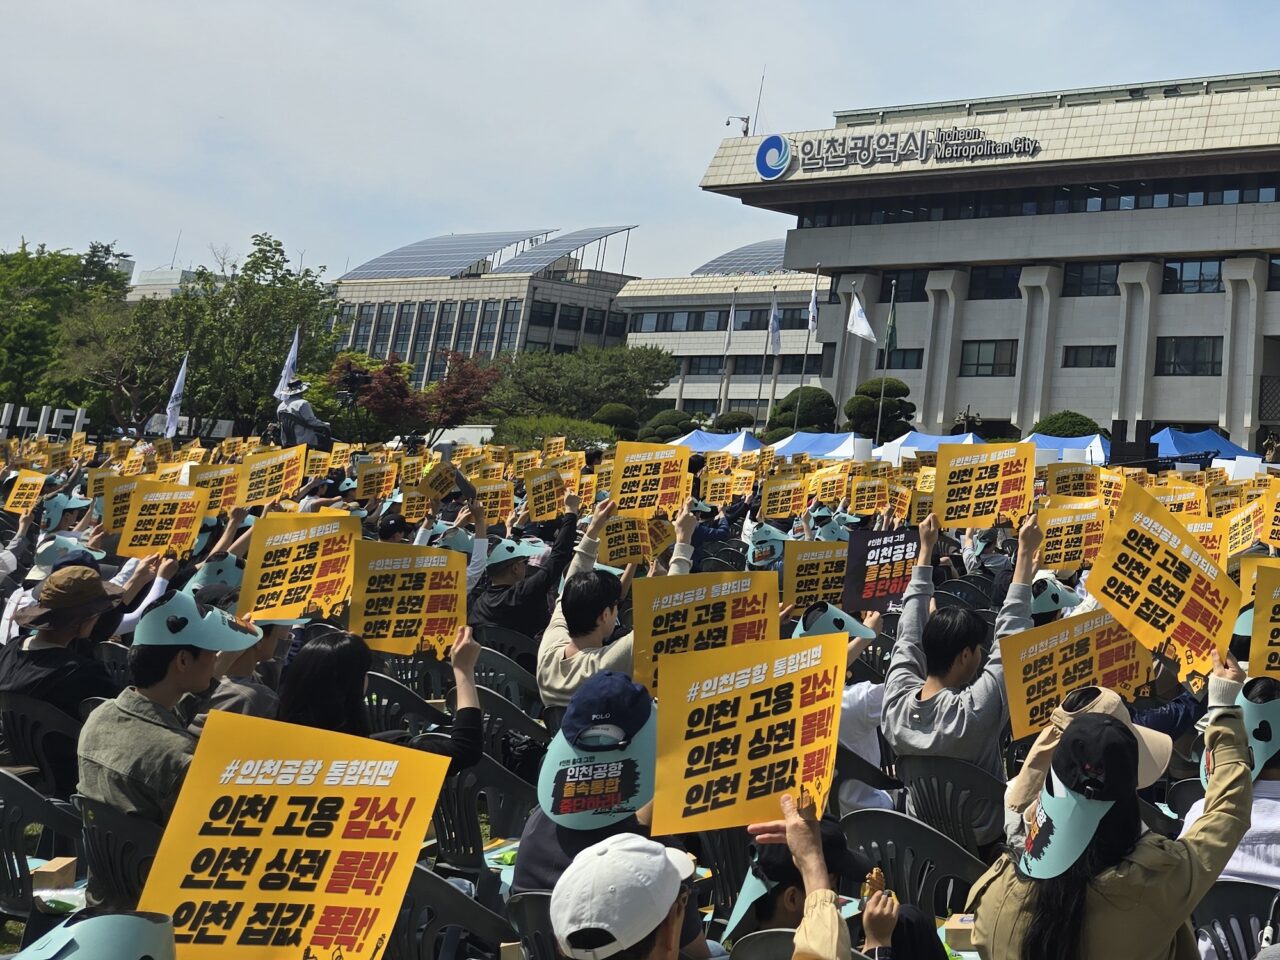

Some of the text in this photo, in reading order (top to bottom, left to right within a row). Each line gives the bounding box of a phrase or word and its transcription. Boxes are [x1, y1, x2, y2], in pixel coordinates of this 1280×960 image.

[800, 129, 927, 169] 인천광역시
[934, 128, 982, 142] Incheon
[934, 136, 1038, 159] Metropolitan City
[620, 475, 682, 495] 인천 상권 몰락!
[622, 460, 683, 479] 인천 고용 감소!
[618, 492, 681, 511] 인천 집값 폭락!
[262, 534, 353, 569] 인천 고용 감소!
[866, 542, 918, 566] 인천공항
[1133, 512, 1220, 581] #인천공항 통합되면
[258, 555, 351, 590] 인천 상권 몰락!
[366, 571, 460, 594] 인천 고용 감소!
[1122, 529, 1229, 614] 인천 고용 감소!
[252, 577, 346, 613] 인천 집값 폭락!
[364, 594, 459, 617] 인천 상권 몰락!
[653, 587, 708, 611] #인천공항
[1112, 553, 1224, 637] 인천 상권 몰락!
[362, 617, 458, 640] 인천 집값 폭락!
[652, 593, 767, 637] 인천 고용 감소!
[732, 619, 768, 645] 몰락!
[1101, 576, 1217, 661] 인천 집값 폭락!
[689, 645, 823, 702] #인천공항 통합되면
[686, 666, 836, 740] 인천 고용 감소!
[685, 704, 835, 779] 인천 상권 몰락!
[221, 760, 399, 787] #인천공항 통합되면
[562, 777, 620, 798] 졸속통합
[566, 762, 624, 782] 인천공항
[683, 744, 831, 818] 인천 집값 폭락!
[200, 795, 414, 839] 인천 고용 감소!
[181, 847, 397, 895] 인천 상권 몰락!
[171, 901, 379, 950] 인천 집값 폭락!
